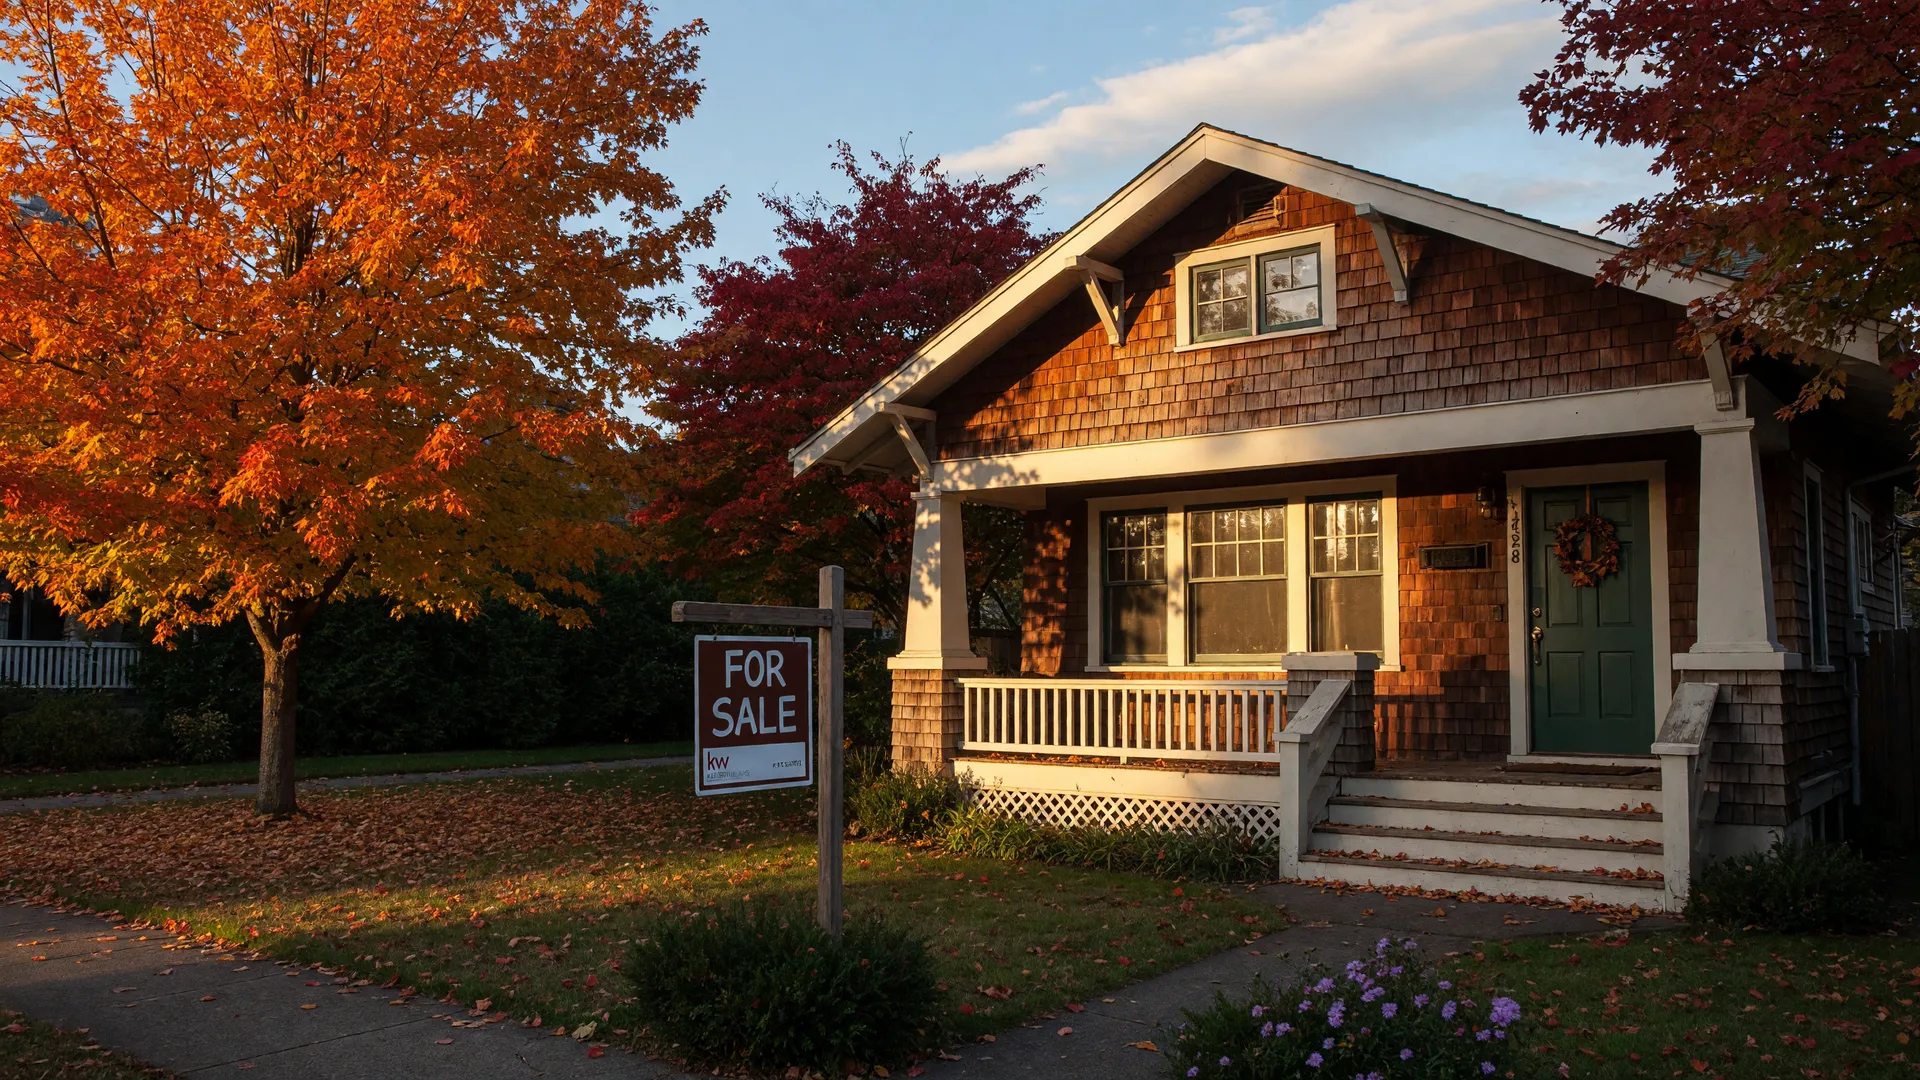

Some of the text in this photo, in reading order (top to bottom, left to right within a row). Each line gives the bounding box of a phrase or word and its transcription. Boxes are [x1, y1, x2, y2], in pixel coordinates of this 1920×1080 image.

[725, 649, 787, 689] FOR
[712, 695, 797, 738] SALE
[707, 751, 730, 771] kw
